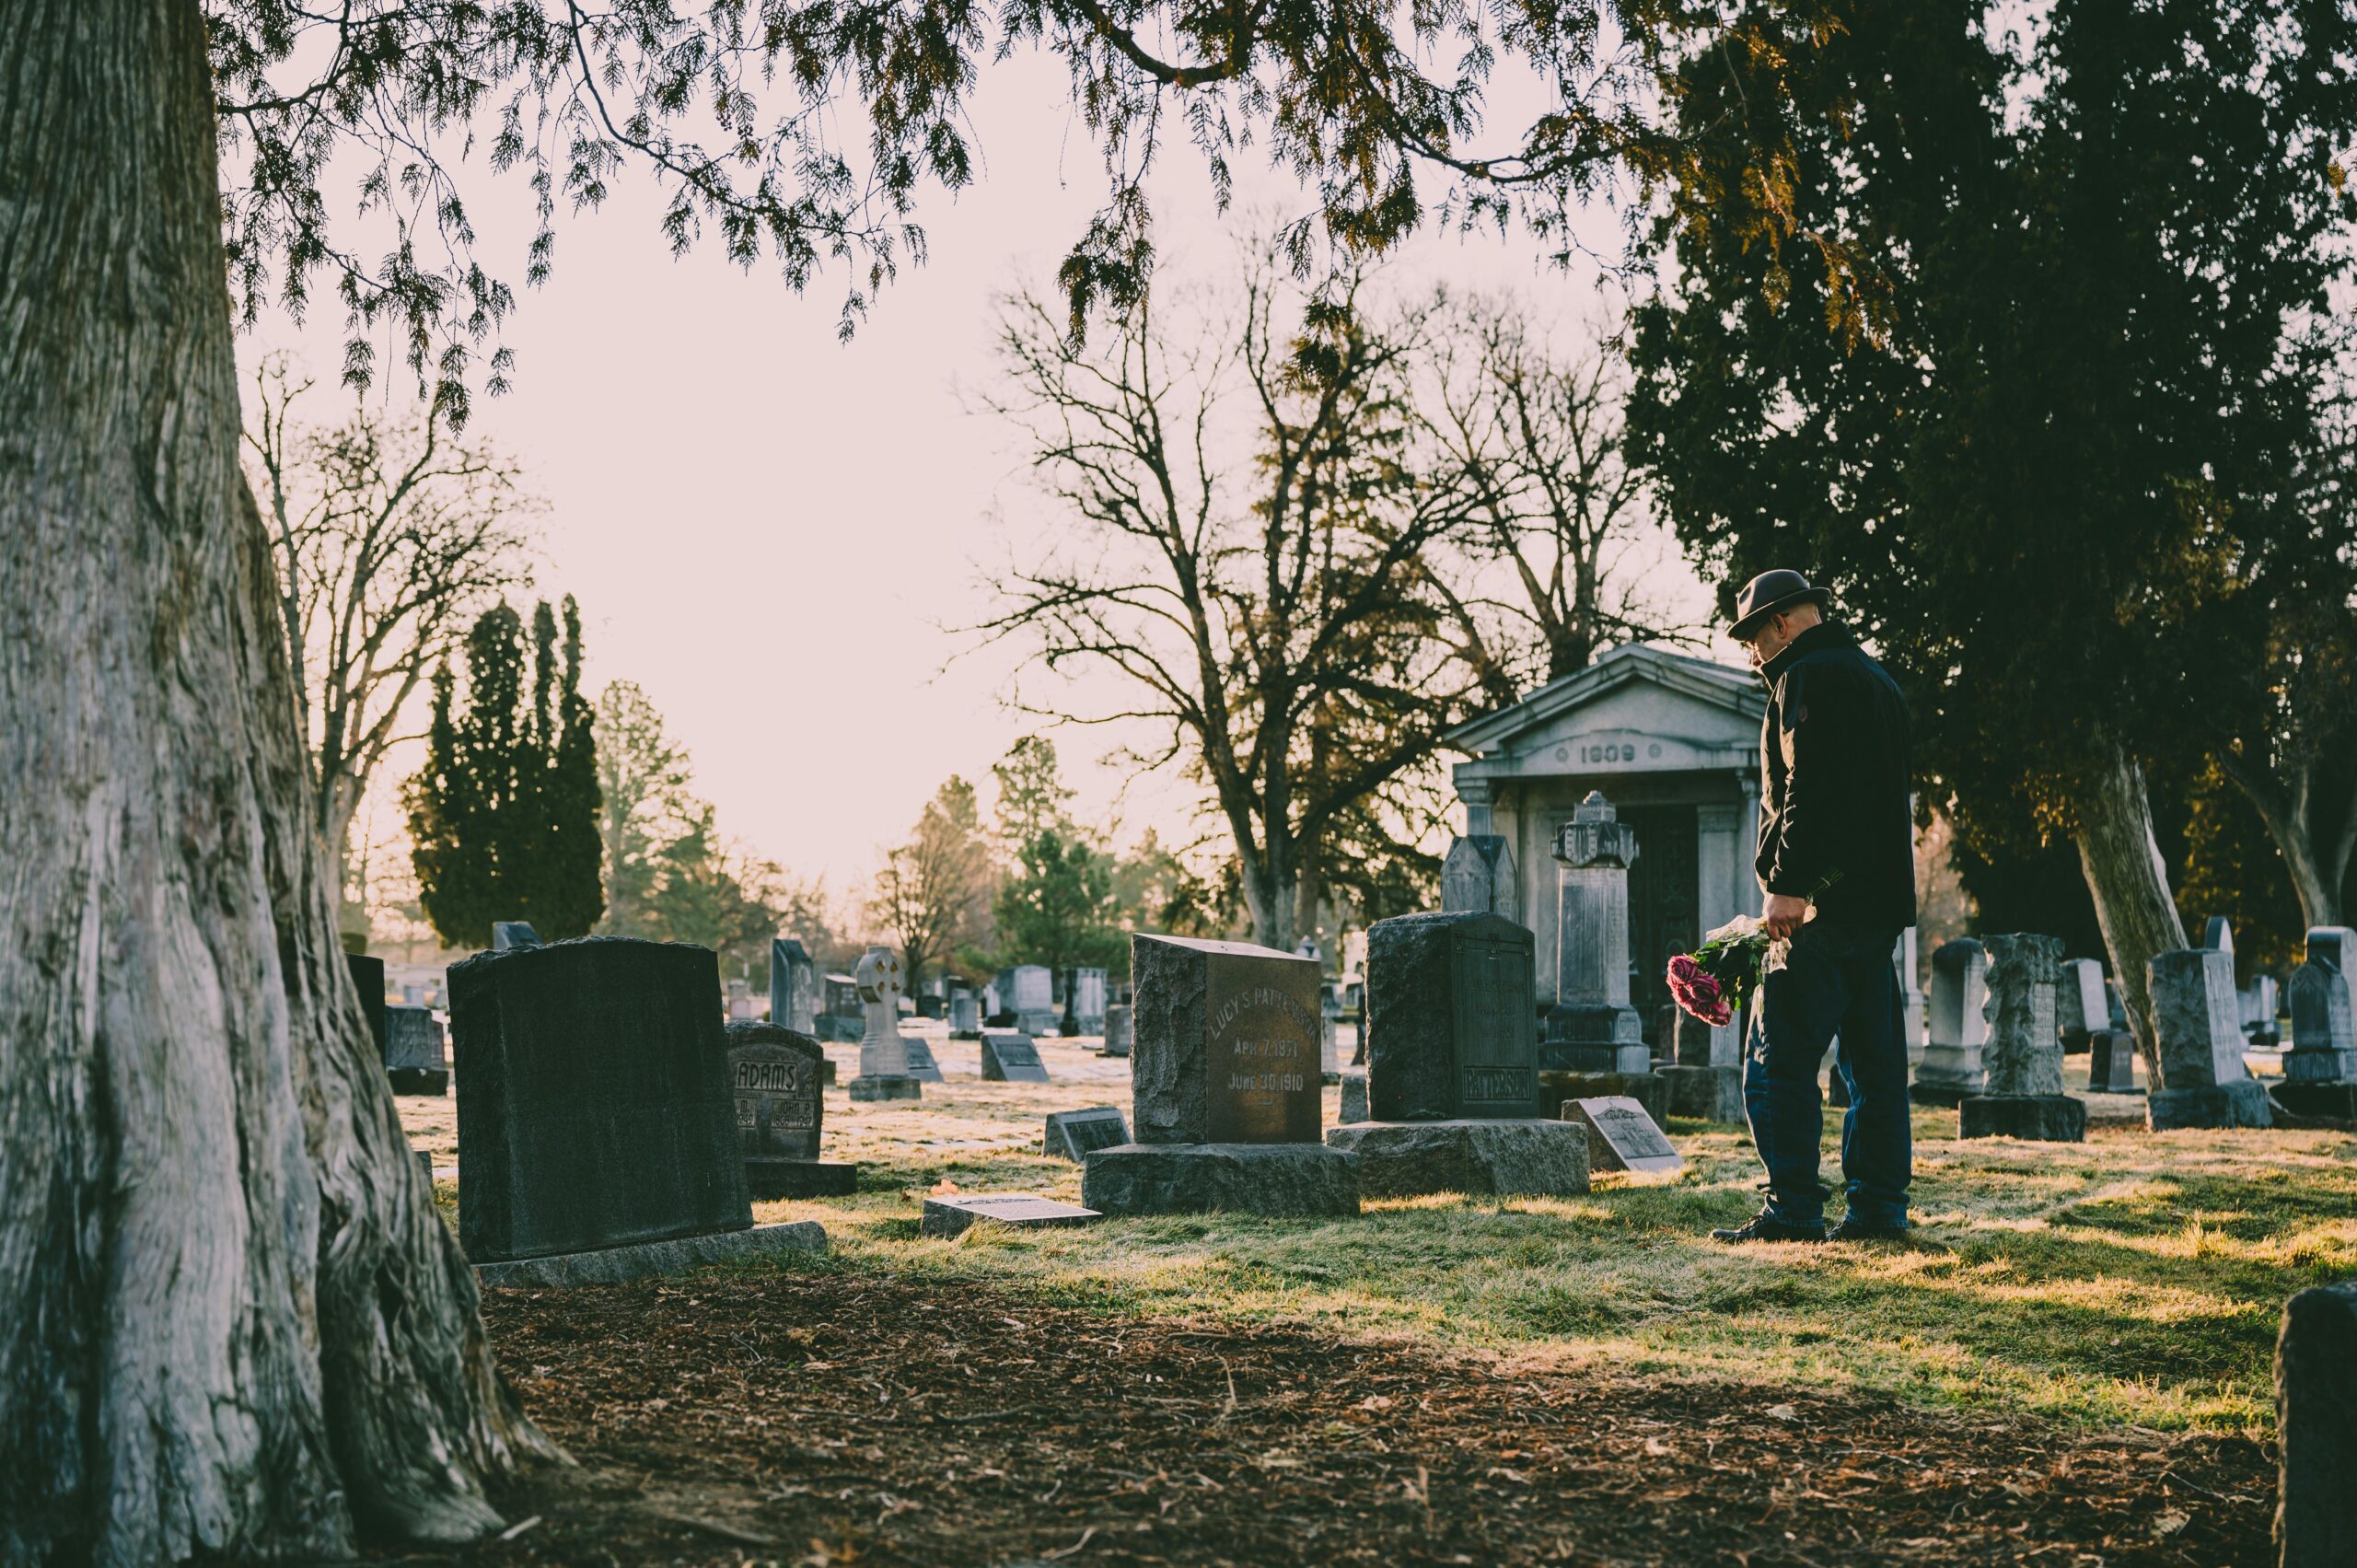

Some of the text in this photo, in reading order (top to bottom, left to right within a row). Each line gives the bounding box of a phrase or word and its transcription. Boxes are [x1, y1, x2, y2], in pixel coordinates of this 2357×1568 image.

[1209, 993, 1239, 1040] LUCY
[1254, 986, 1318, 1045] PATTERSON
[737, 1062, 795, 1089] ADAMS
[1281, 1074, 1304, 1092] 1910
[1465, 1069, 1529, 1098] PATTERSON
[740, 1099, 750, 1113] M.
[779, 1101, 799, 1114] JOHN
